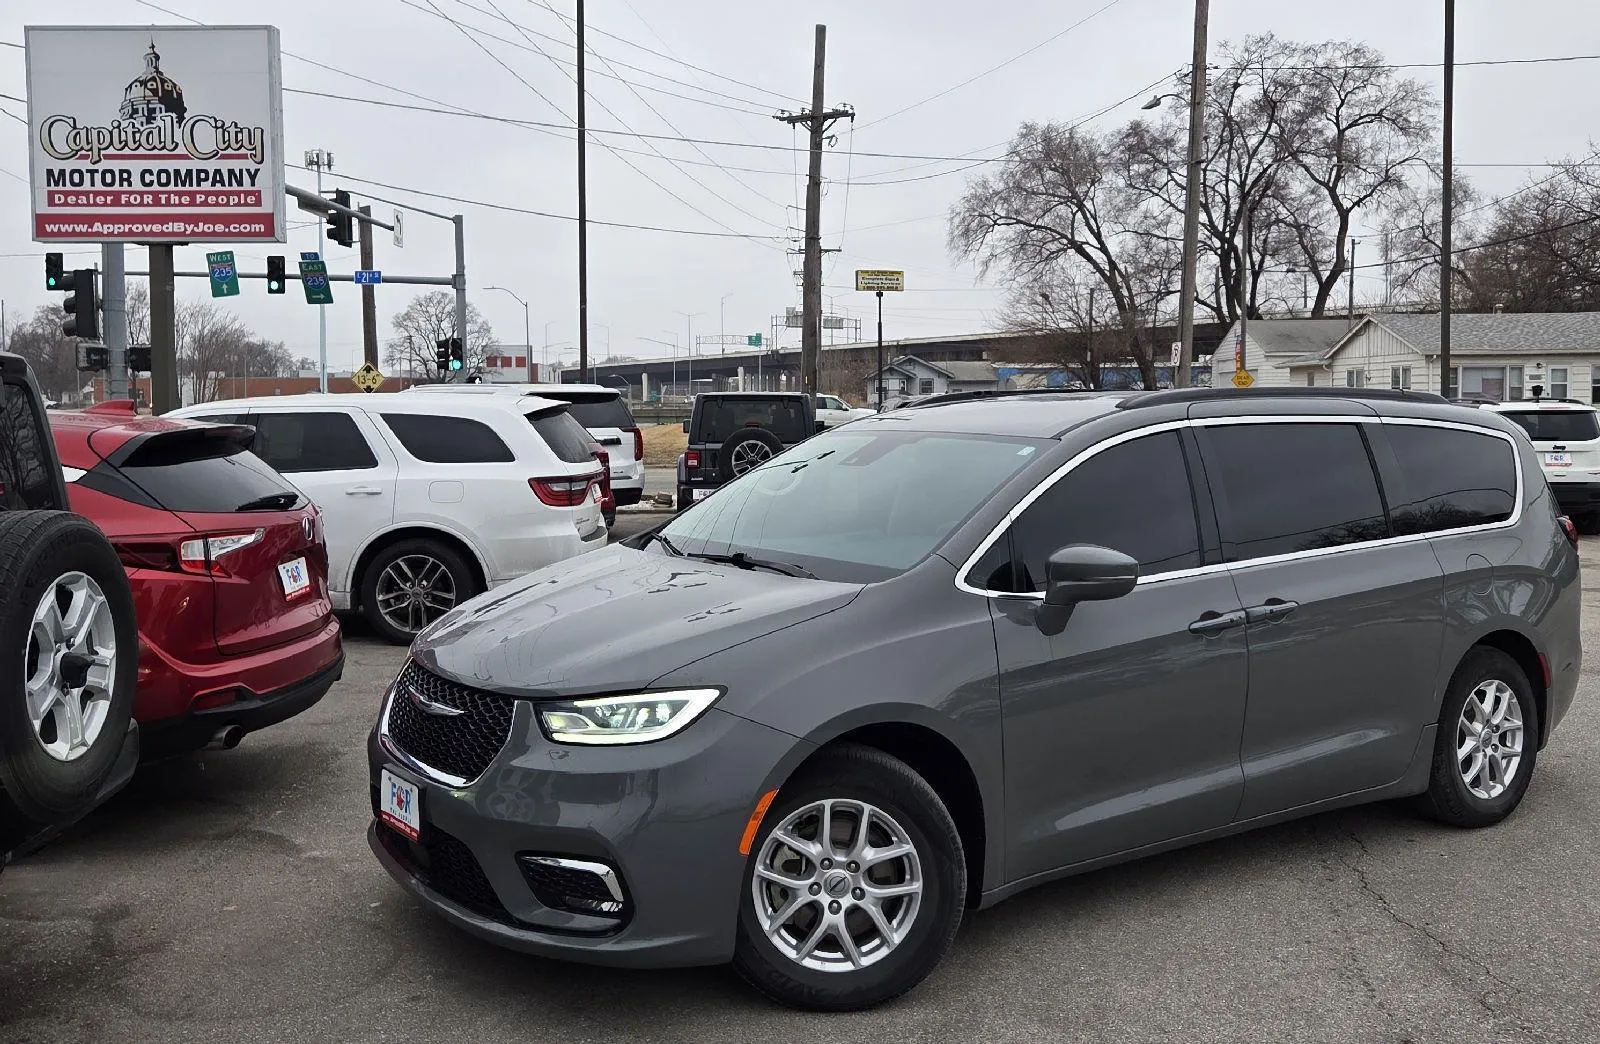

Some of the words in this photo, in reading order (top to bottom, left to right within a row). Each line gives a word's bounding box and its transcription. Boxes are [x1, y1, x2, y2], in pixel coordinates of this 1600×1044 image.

[40, 114, 178, 164] Capital
[182, 115, 264, 164] City
[46, 168, 132, 188] MOTOR
[139, 168, 260, 188] COMPANY
[54, 194, 114, 205] Dealer
[121, 194, 153, 204] FOR
[159, 194, 190, 204] The
[196, 193, 256, 207] People
[45, 221, 265, 235] www.ApprovedByJoe.com
[213, 267, 233, 277] 235
[306, 276, 326, 286] 235
[391, 782, 411, 815] FOR
